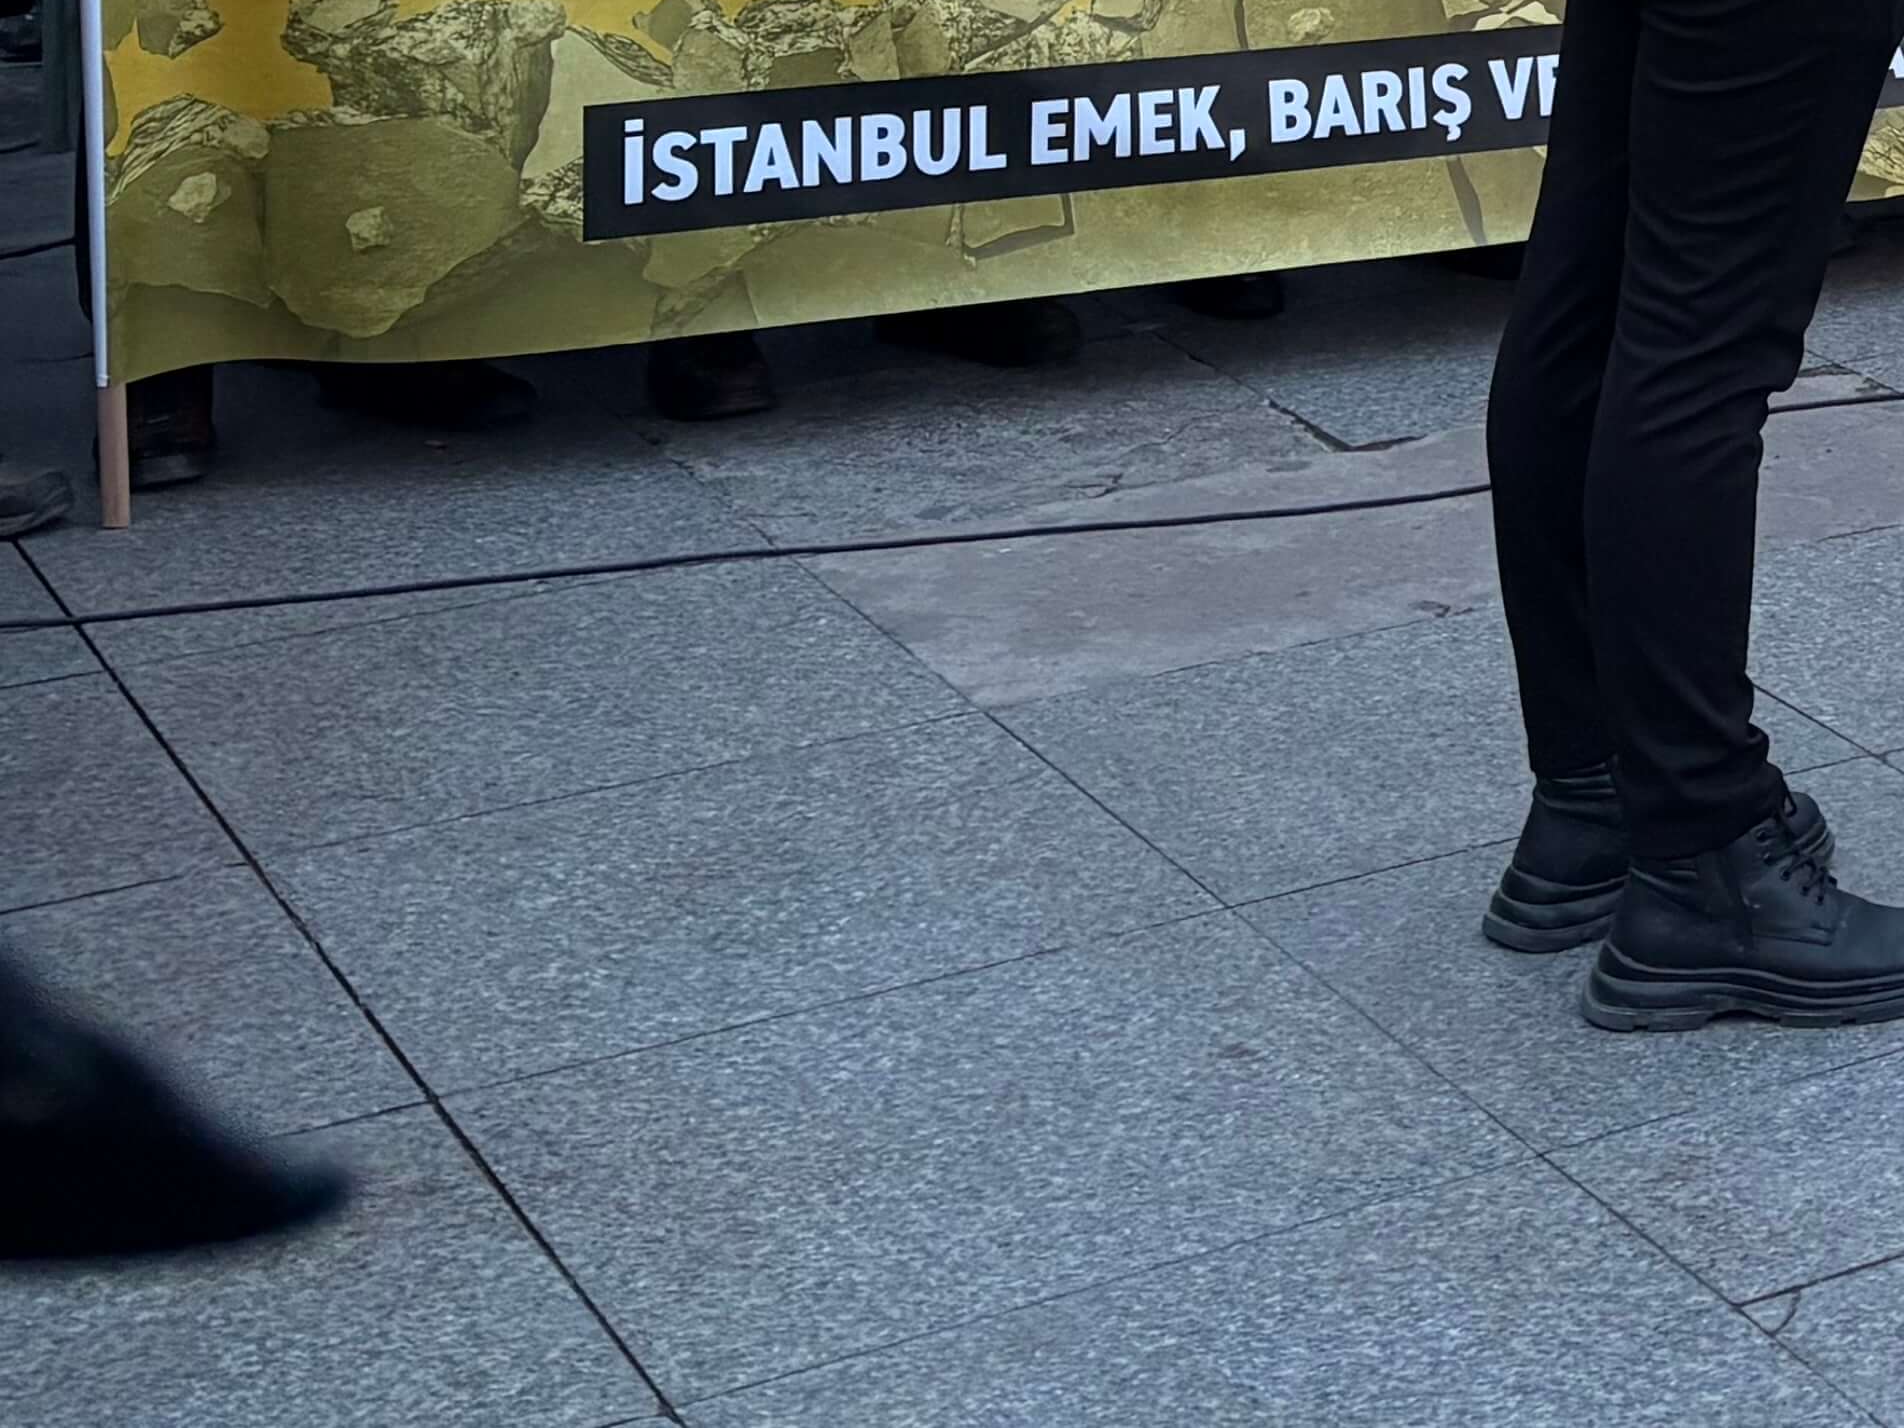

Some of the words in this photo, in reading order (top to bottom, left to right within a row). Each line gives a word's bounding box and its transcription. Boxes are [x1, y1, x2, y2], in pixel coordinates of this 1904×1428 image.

[623, 111, 1007, 206] İSTANBUL
[1028, 83, 1246, 167] EMEK,
[1267, 63, 1473, 147] BARIŞ
